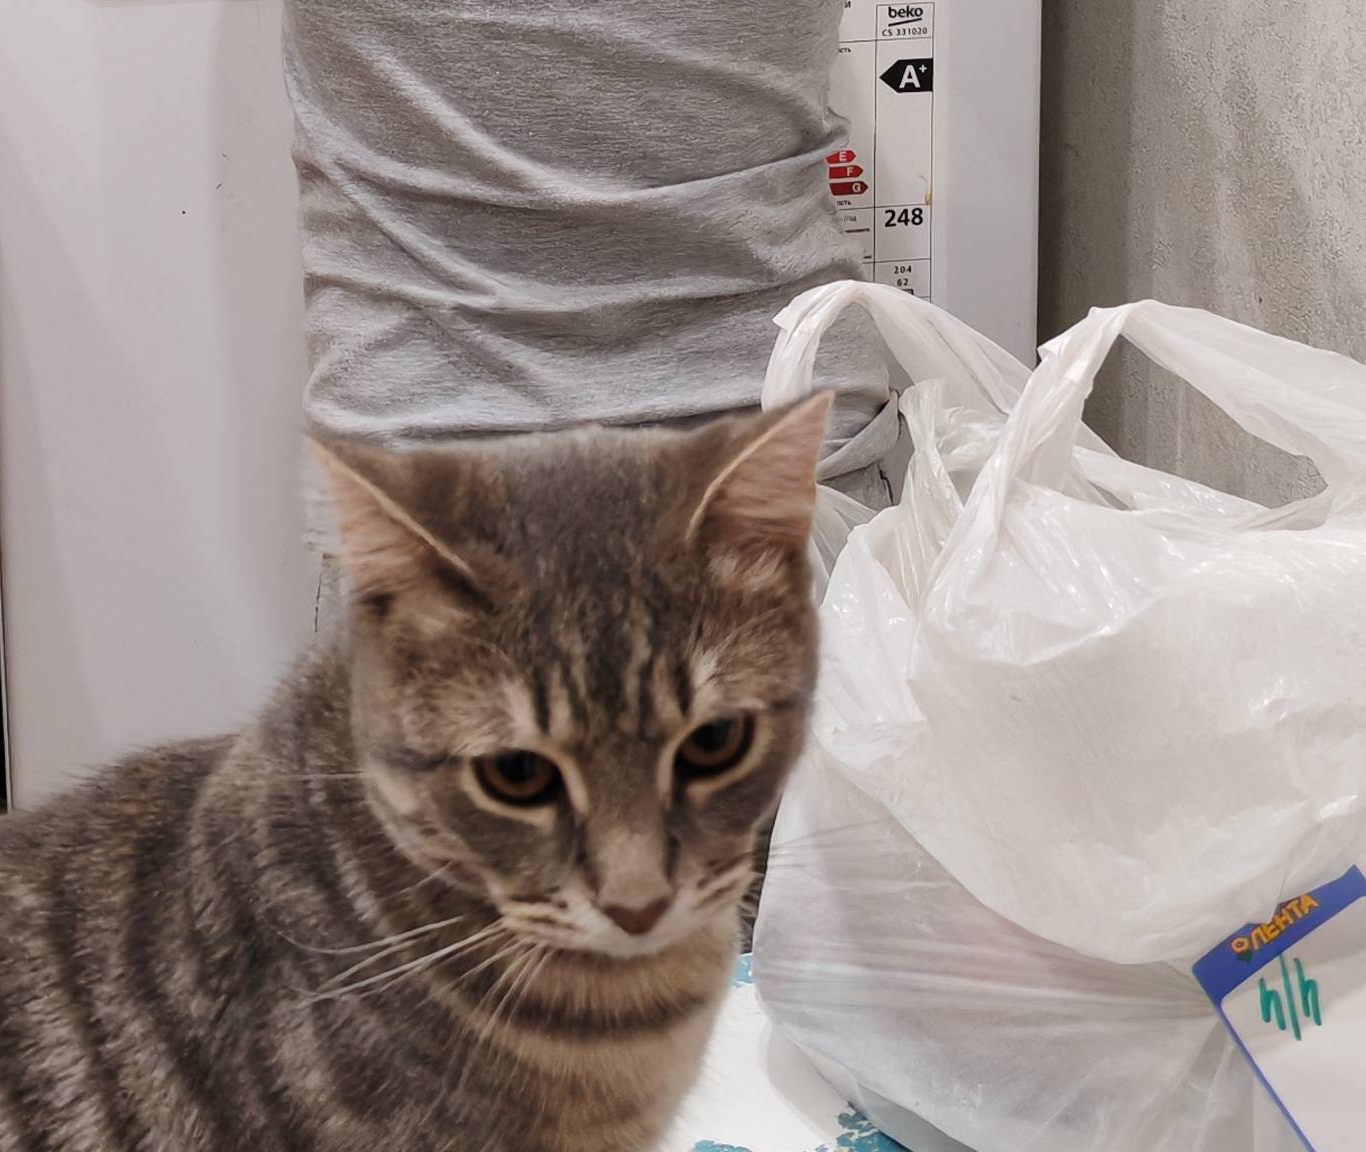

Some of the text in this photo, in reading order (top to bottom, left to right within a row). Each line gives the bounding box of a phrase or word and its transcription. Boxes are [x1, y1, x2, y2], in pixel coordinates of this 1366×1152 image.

[888, 5, 924, 19] beko
[838, 151, 848, 162] E
[846, 167, 855, 177] F
[852, 183, 861, 193] G
[885, 208, 923, 227] 248
